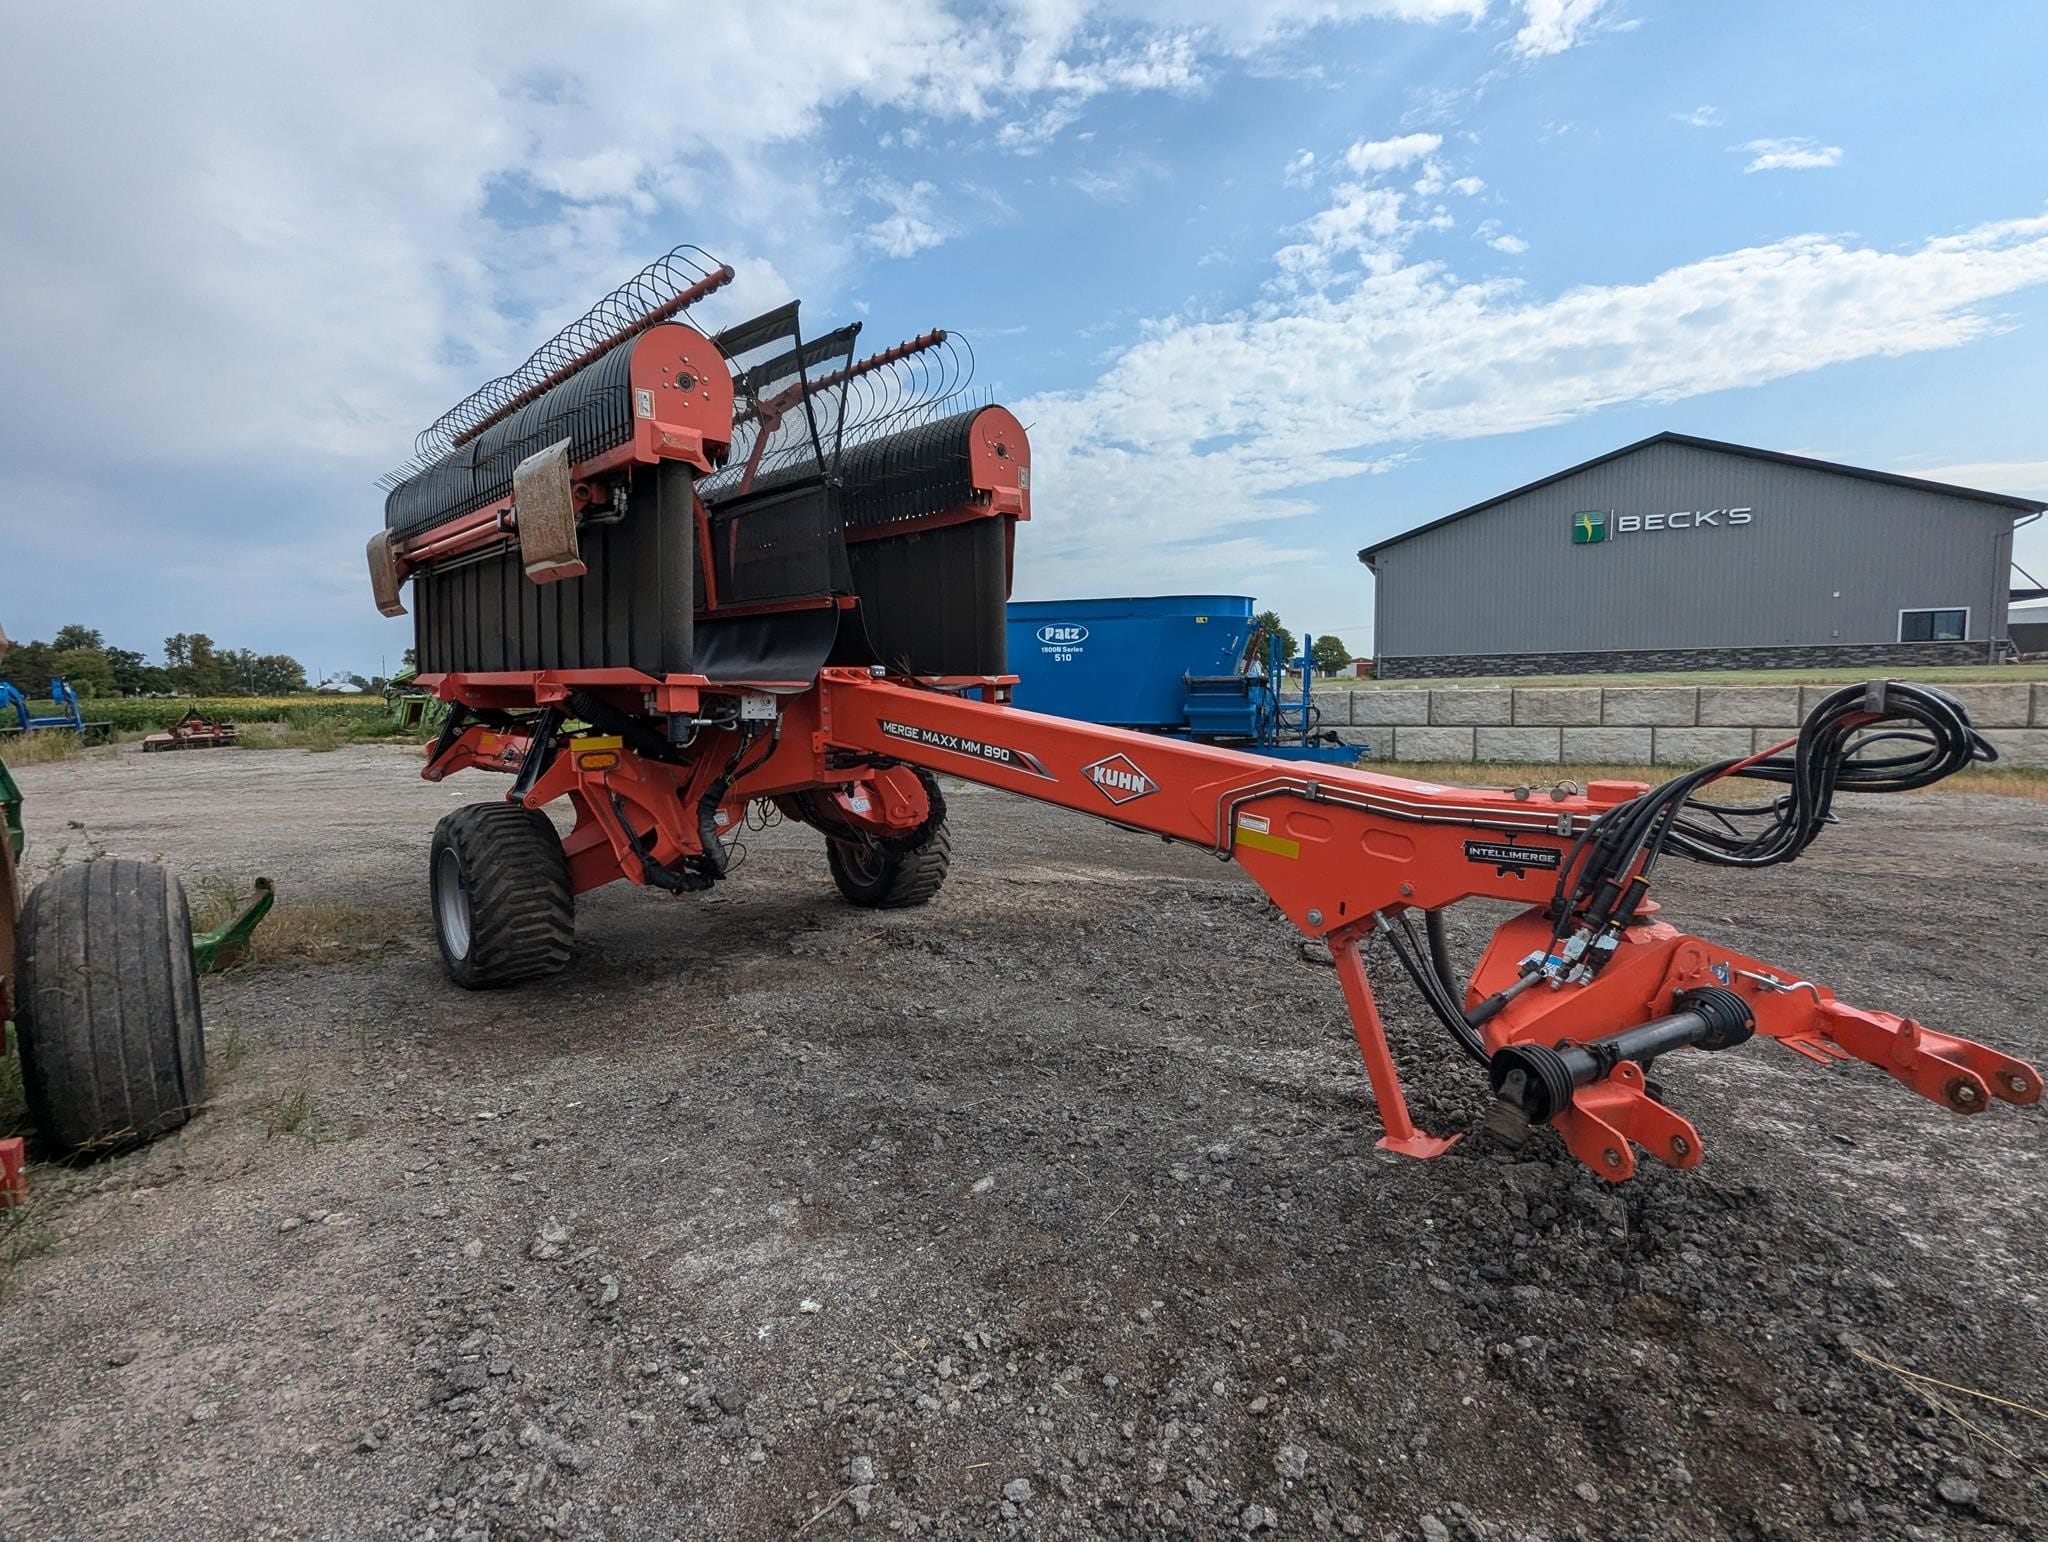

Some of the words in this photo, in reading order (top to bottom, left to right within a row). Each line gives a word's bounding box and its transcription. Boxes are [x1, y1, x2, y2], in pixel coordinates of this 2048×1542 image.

[1618, 507, 1752, 532] BECK'S
[1045, 627, 1080, 640] Patz
[1054, 653, 1072, 662] 510
[883, 721, 919, 739] MERGE
[922, 730, 958, 749] MAXX
[961, 740, 980, 754] MM
[983, 745, 1010, 761] 890
[1093, 766, 1145, 793] KUHN
[1469, 847, 1556, 863] INTELLIMERGE
